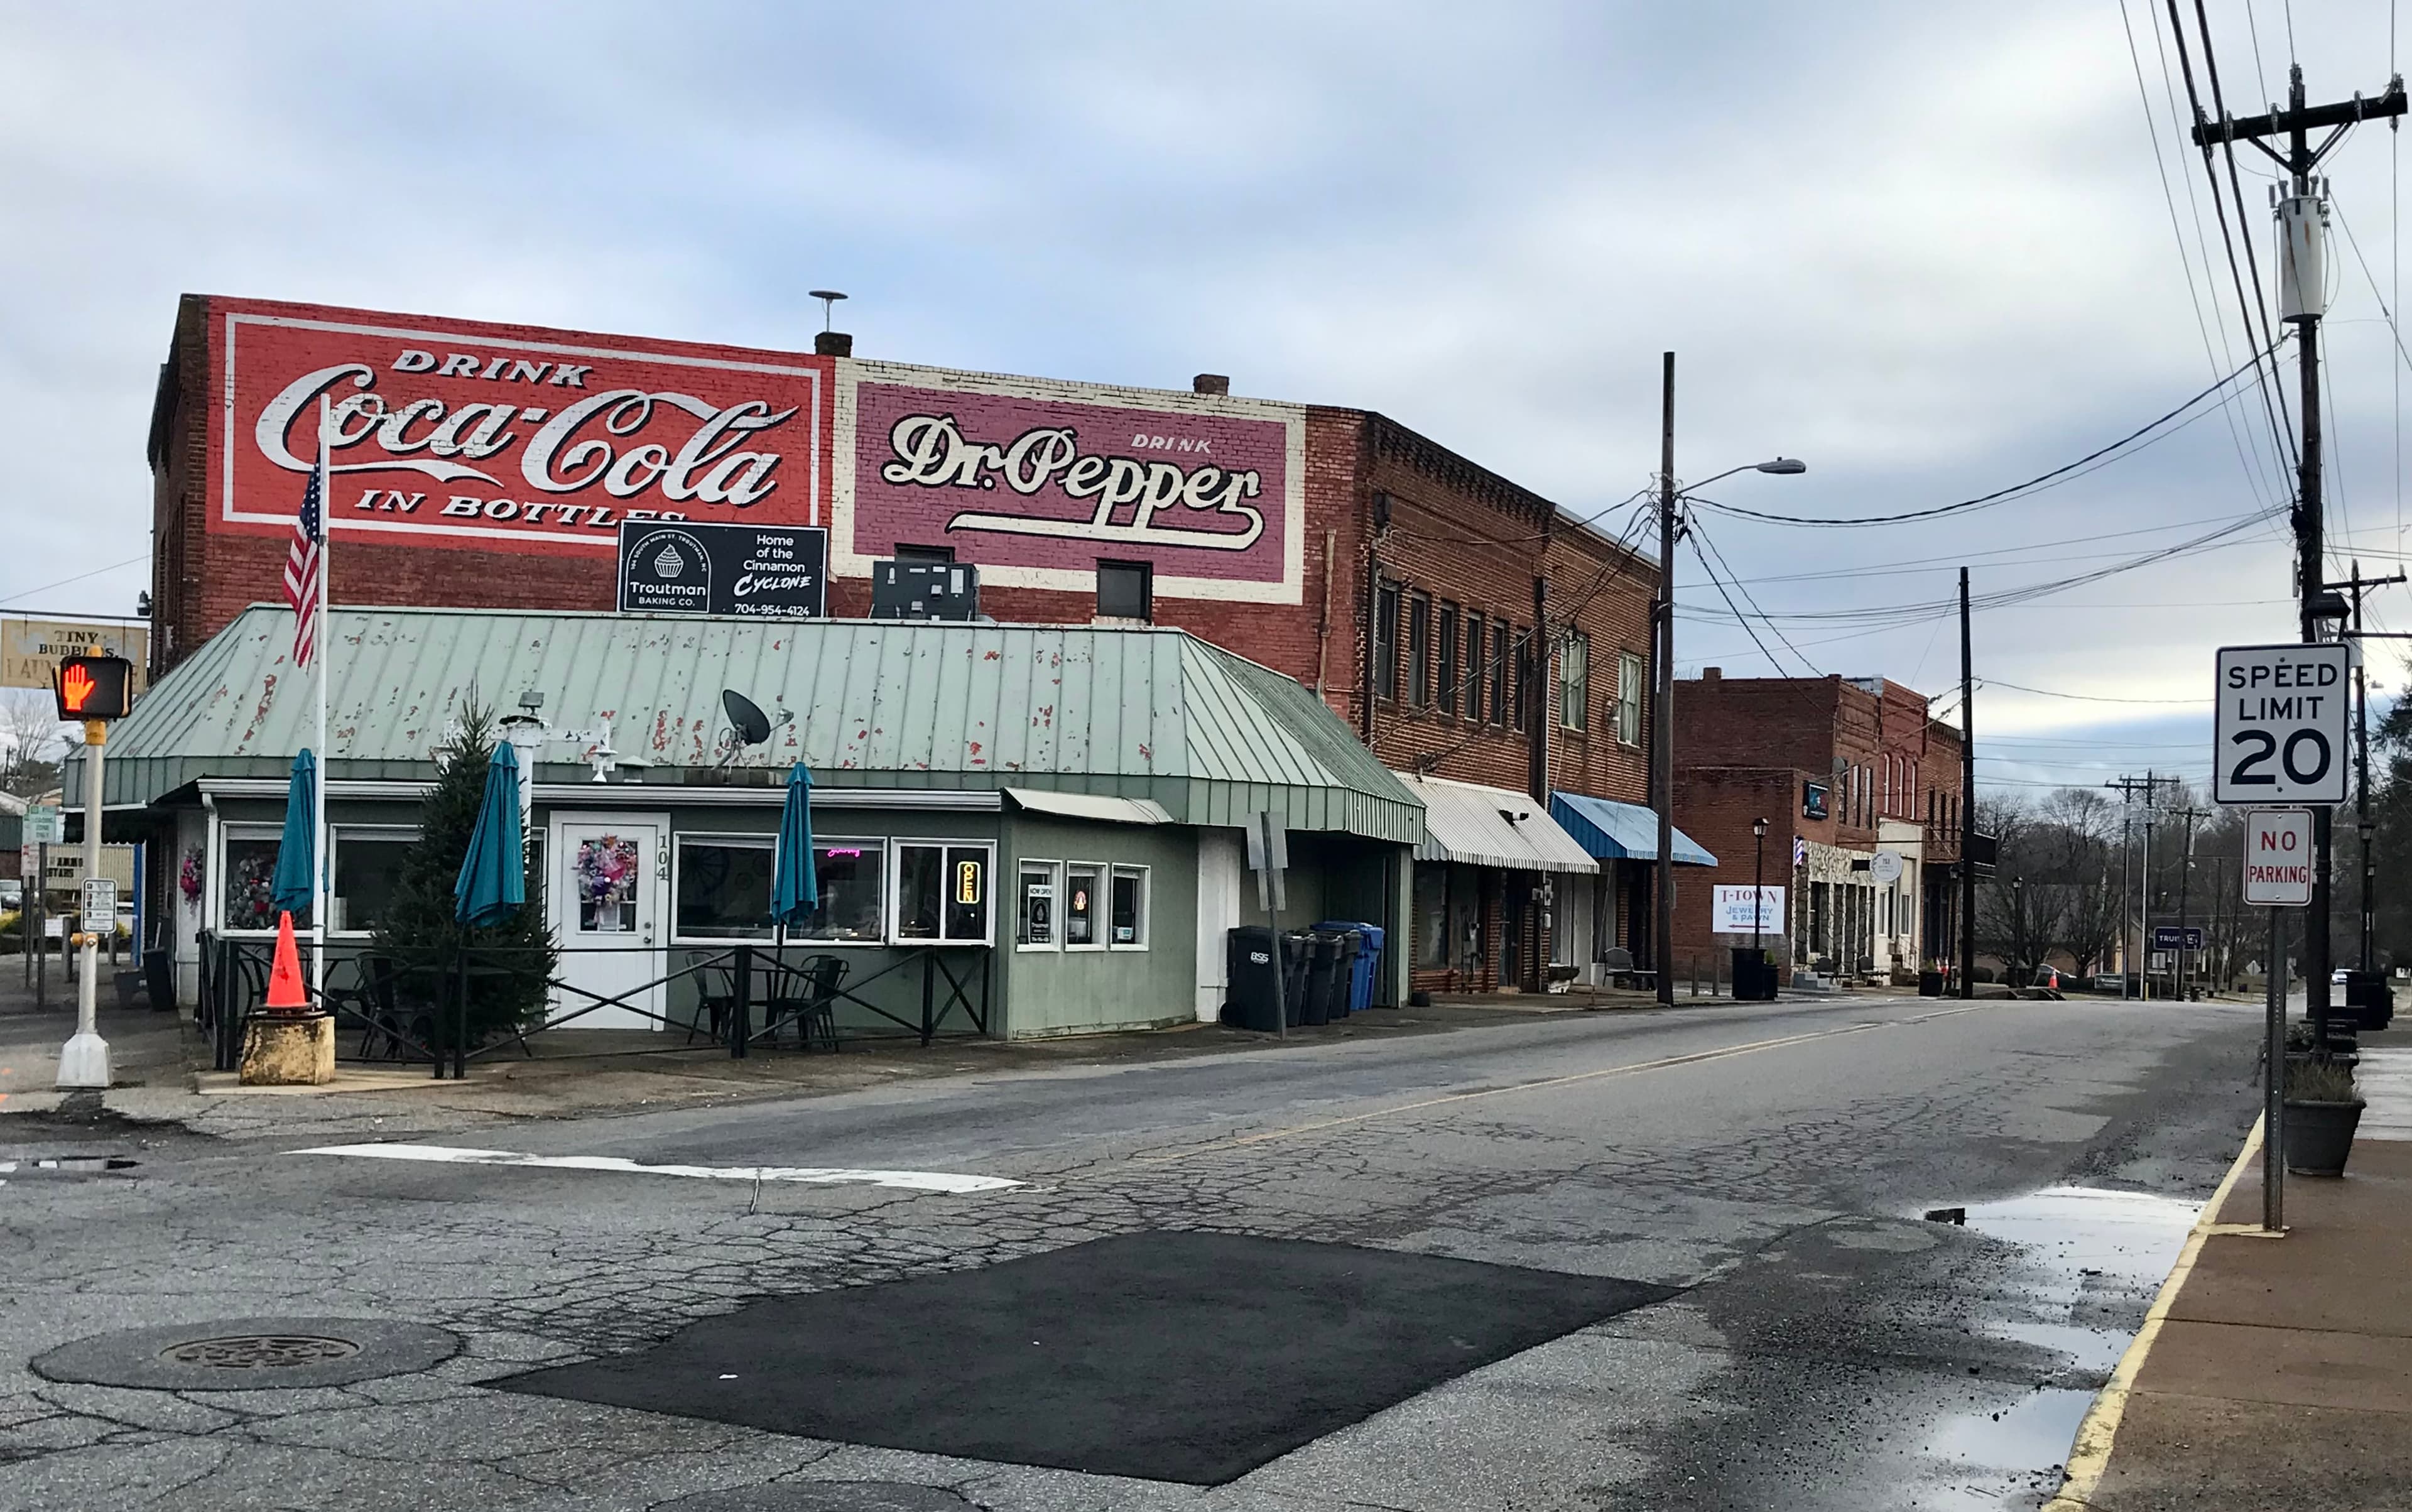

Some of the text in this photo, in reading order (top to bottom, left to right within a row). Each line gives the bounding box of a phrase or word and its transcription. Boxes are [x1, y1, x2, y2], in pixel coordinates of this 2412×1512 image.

[391, 349, 593, 387] DRINK
[256, 363, 800, 506] Coca-Cola
[1131, 433, 1212, 454] DRINK
[354, 489, 426, 513] IN
[634, 541, 650, 558] SOUTH
[649, 534, 666, 542] MAIN
[756, 535, 794, 547] Home
[756, 548, 793, 559] of the
[743, 560, 805, 573] Cinnamon
[630, 582, 706, 596] Troutman
[639, 597, 676, 606] BAKING
[735, 604, 810, 616] 704-954-4124
[55, 630, 99, 644] TINY
[2228, 663, 2338, 689] SPEED
[2239, 696, 2324, 721] LIMIT
[2230, 729, 2331, 785] 20
[2261, 830, 2296, 851] NO
[657, 835, 668, 880] 104
[964, 864, 974, 901] OPEN
[2249, 865, 2307, 884] PARKING
[1721, 890, 1777, 903] T-TOWN
